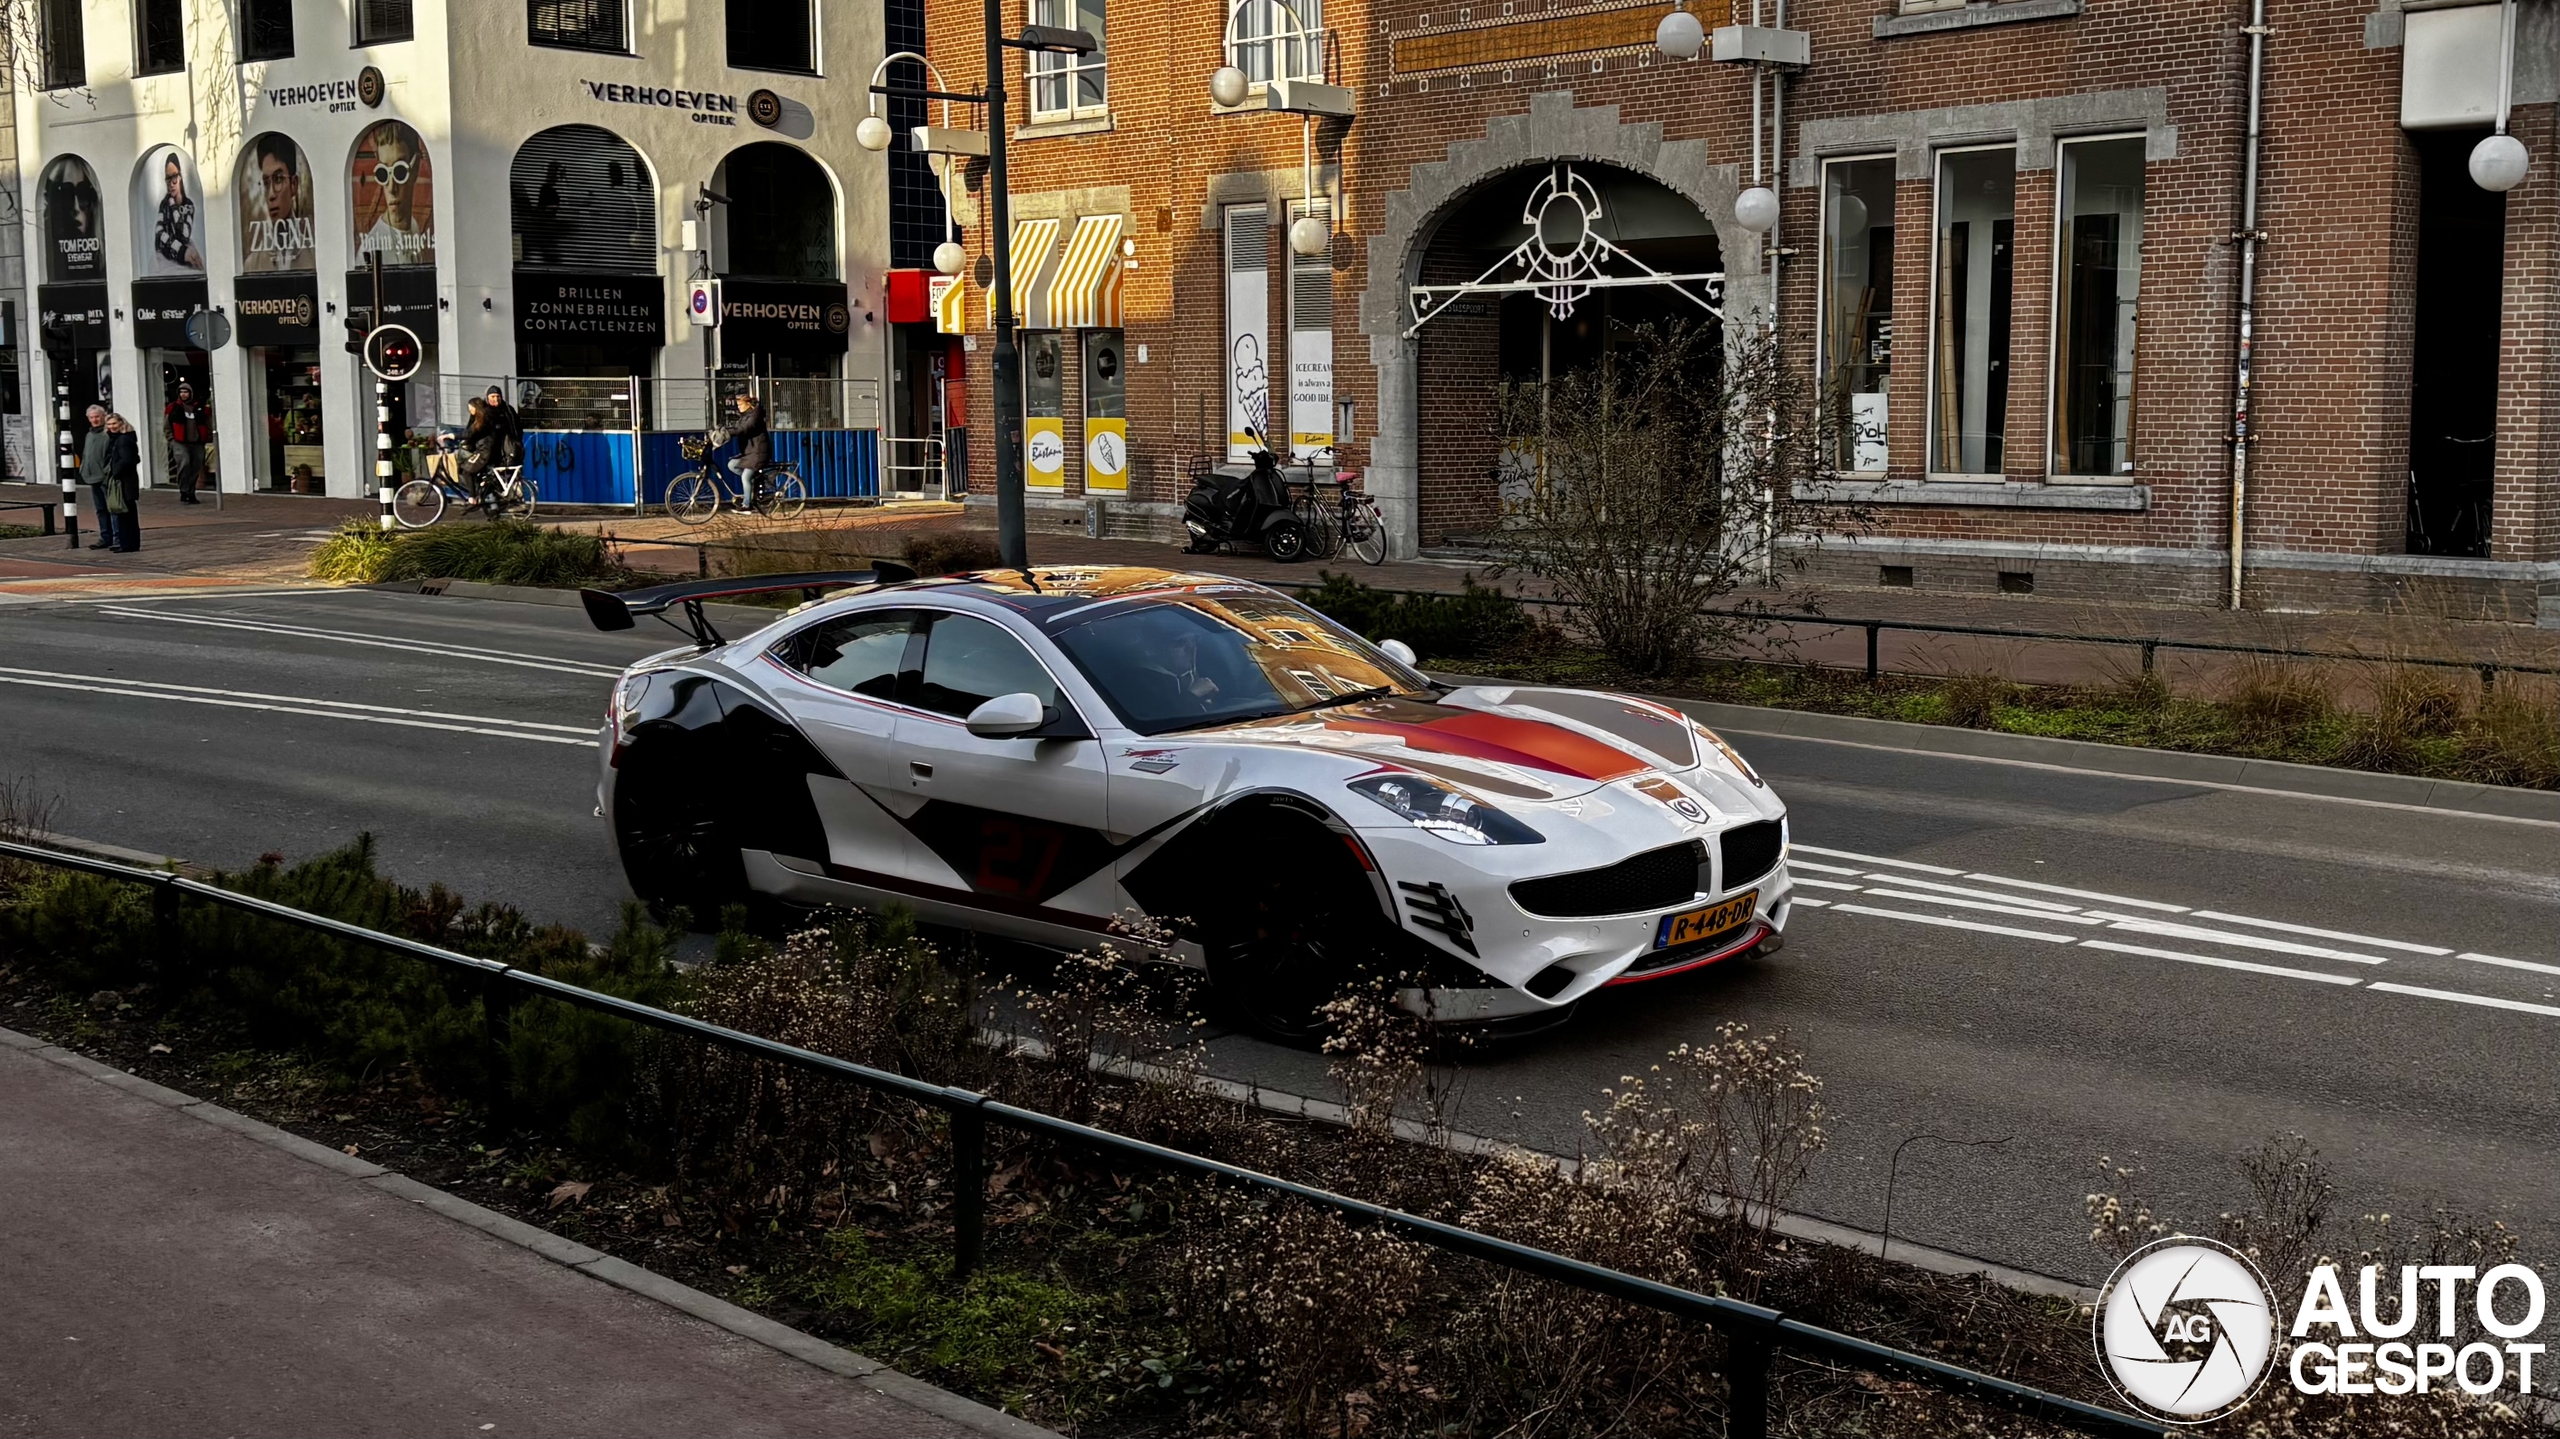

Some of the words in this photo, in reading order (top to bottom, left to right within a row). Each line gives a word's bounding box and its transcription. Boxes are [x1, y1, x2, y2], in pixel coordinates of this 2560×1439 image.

[269, 80, 356, 108] VERHOEVEN
[589, 81, 735, 113] VERHOEVEN
[329, 101, 356, 114] OPTIEK
[691, 113, 735, 126] OPTIEK
[249, 217, 316, 252] ZEGNA
[58, 239, 77, 253] TOM
[77, 237, 99, 252] FORD
[558, 286, 622, 300] BRILLEN
[530, 302, 649, 317] ZONNEBRILLEN
[721, 302, 820, 320] VERHOEVEN
[524, 318, 656, 333] CONTACTLENZEN
[787, 321, 820, 330] OPTIEK
[1294, 393, 1317, 402] GOOD
[976, 819, 1064, 899] 27
[1674, 897, 1753, 941] R-448-DR
